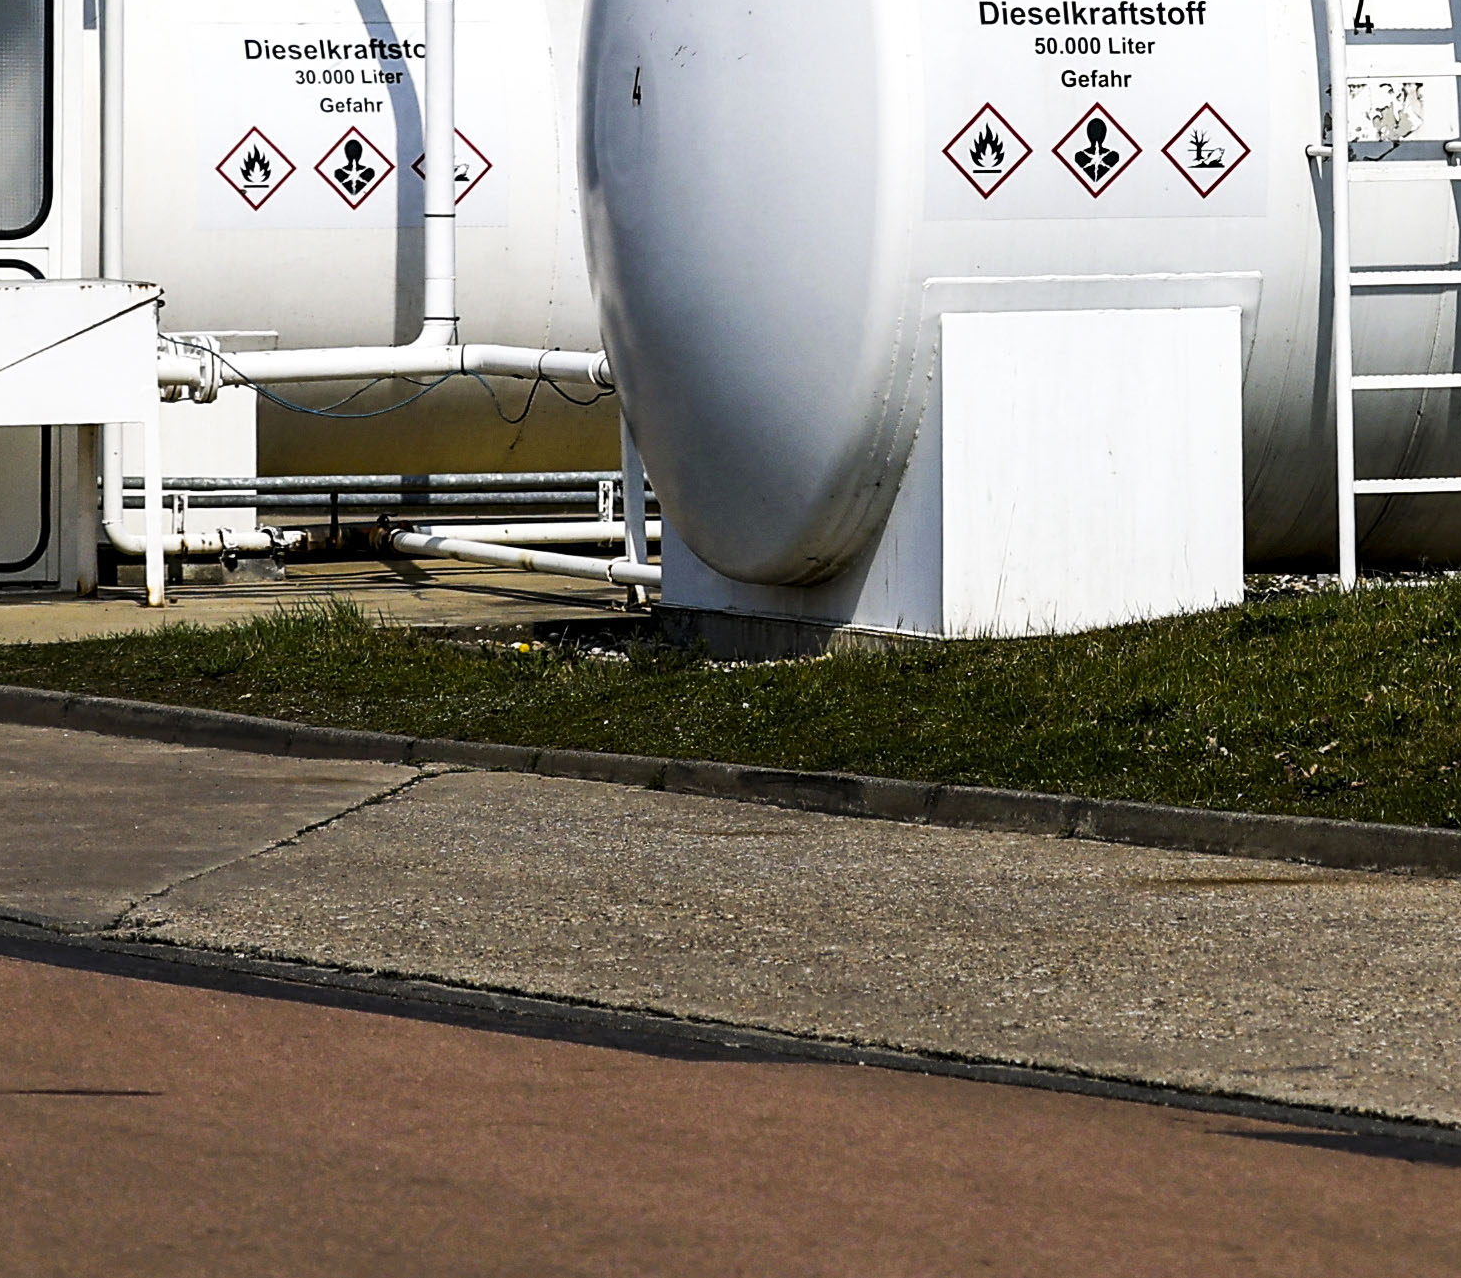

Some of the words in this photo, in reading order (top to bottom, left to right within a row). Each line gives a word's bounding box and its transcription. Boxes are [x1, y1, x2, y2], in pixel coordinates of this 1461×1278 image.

[978, 0, 1207, 26] Dieselkraftstoff
[243, 38, 426, 61] Dieselkraftsto
[1034, 36, 1101, 56] 50.000
[1108, 36, 1156, 55] Liter
[295, 69, 355, 85] 30.000
[361, 69, 403, 85] Liter
[1060, 69, 1132, 88] Gefahr
[319, 97, 383, 113] Gefahr
